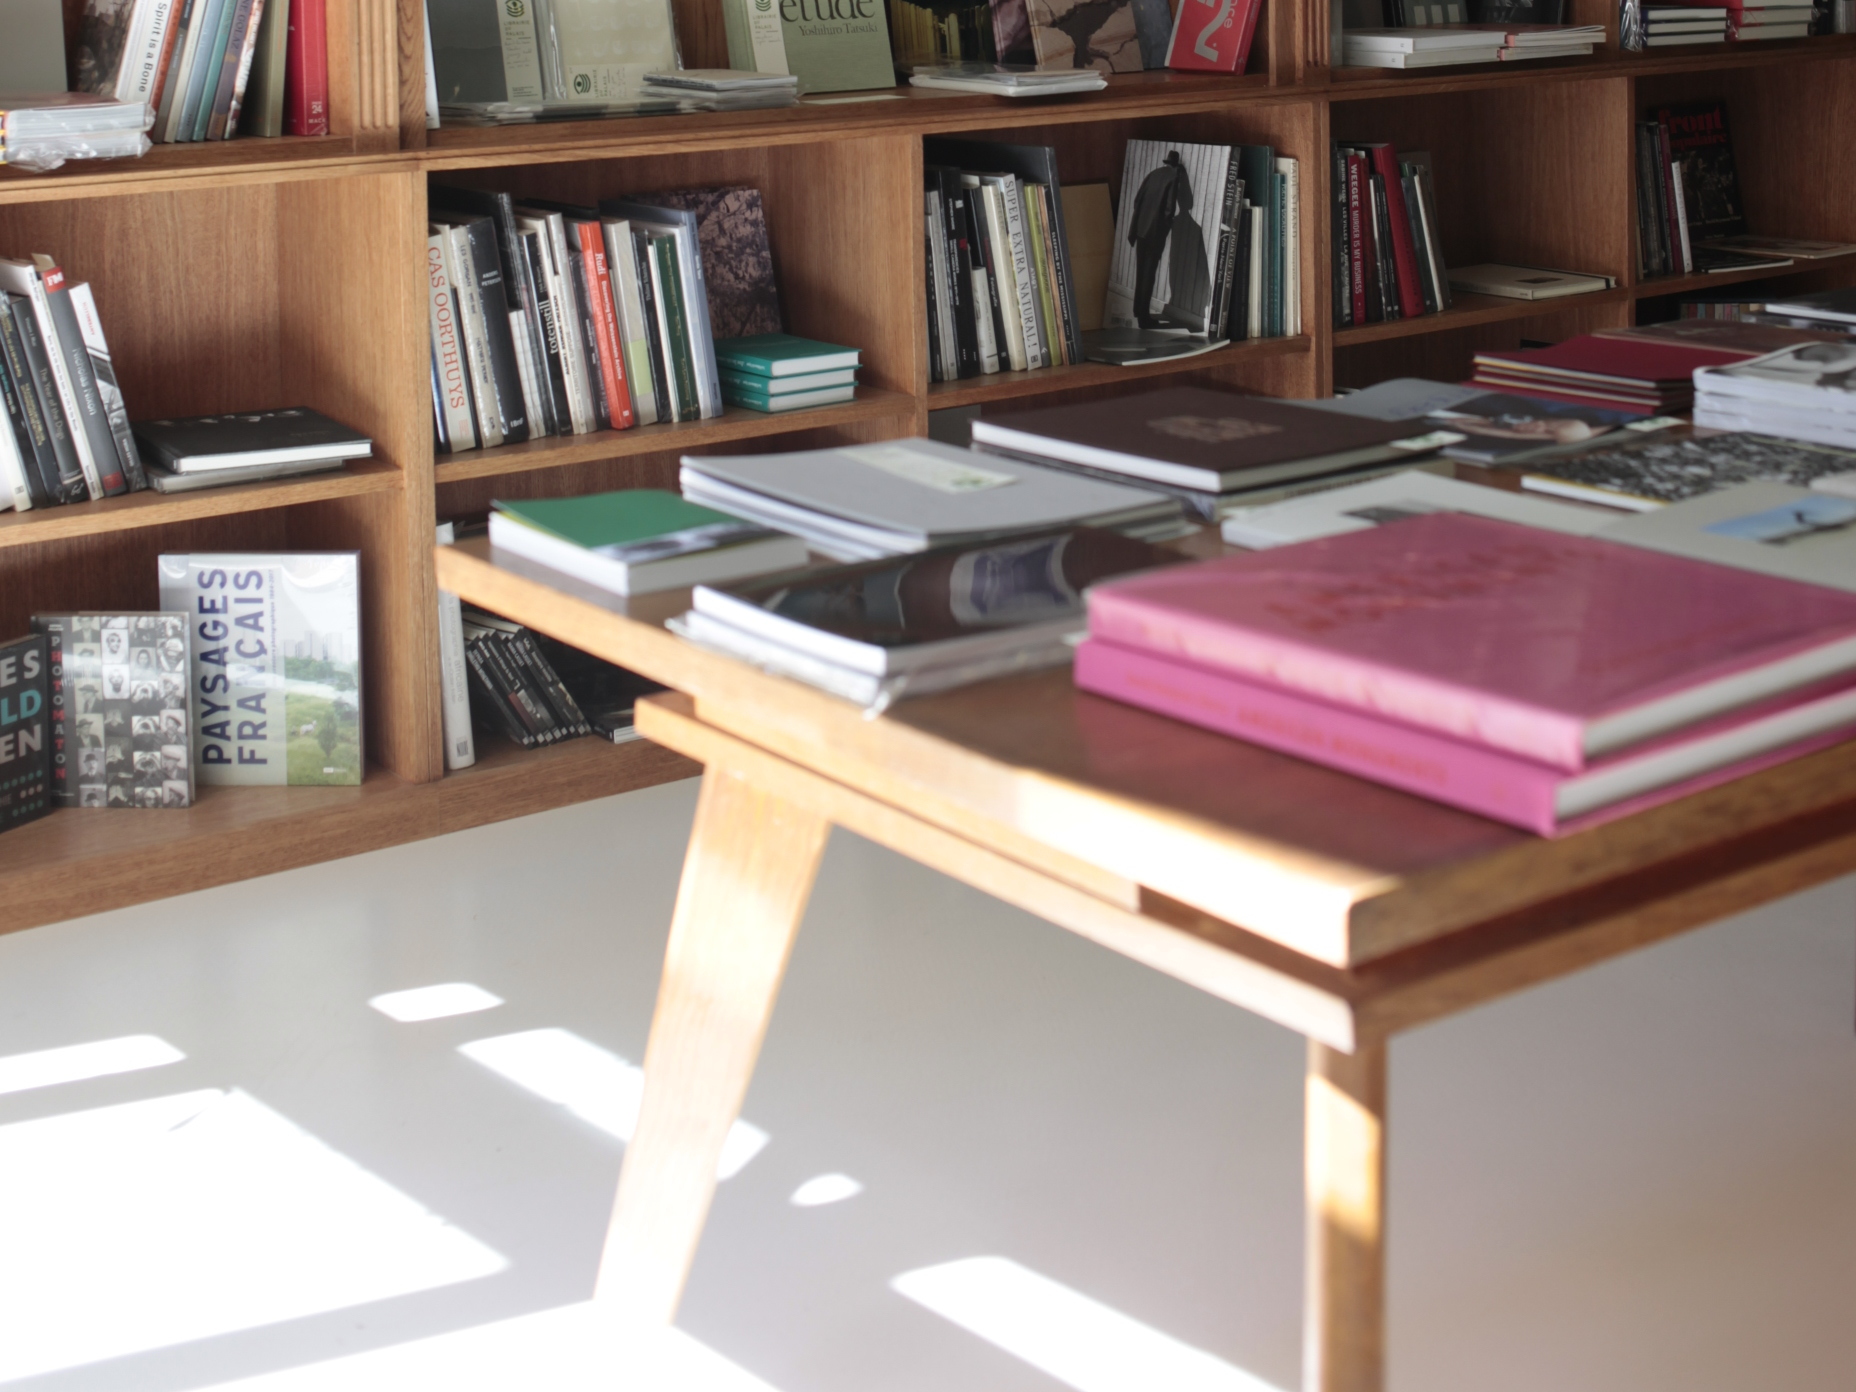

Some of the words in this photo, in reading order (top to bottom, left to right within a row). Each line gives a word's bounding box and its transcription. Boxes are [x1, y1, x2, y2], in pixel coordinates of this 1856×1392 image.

[151, 2, 168, 35] Spirit
[798, 24, 842, 36] Yoshihiro
[843, 22, 878, 34] Tatsuki
[139, 63, 154, 92] Bone
[312, 104, 323, 114] 24
[1229, 161, 1238, 181] FRED
[1351, 164, 1359, 207] WEEGEE
[1226, 183, 1235, 206] STEIN
[1352, 210, 1360, 239] MURDER
[428, 247, 446, 288] CAS
[463, 258, 472, 287] GORGAN
[595, 253, 606, 276] Rudi
[1005, 180, 1019, 223] SUPER
[1012, 232, 1026, 274] EXTRA
[1019, 281, 1038, 348] NATURAL!
[1051, 232, 1060, 260] SLEEPING
[1059, 285, 1068, 320] MISSISSIPPI
[1353, 261, 1362, 294] BUSINESS
[538, 300, 559, 354] totenstill
[601, 281, 611, 312] Discovering
[614, 359, 622, 380] Archive
[434, 293, 465, 409] OORTHUYS
[72, 348, 90, 387] Nicholas
[82, 390, 97, 416] Nixon
[43, 383, 54, 397] Year
[52, 422, 64, 440] Dogs
[198, 569, 232, 765] PAYSAGES
[233, 570, 268, 765] FRANÇAIS
[454, 660, 464, 703] africaine
[51, 636, 66, 779] PHOTOMATON
